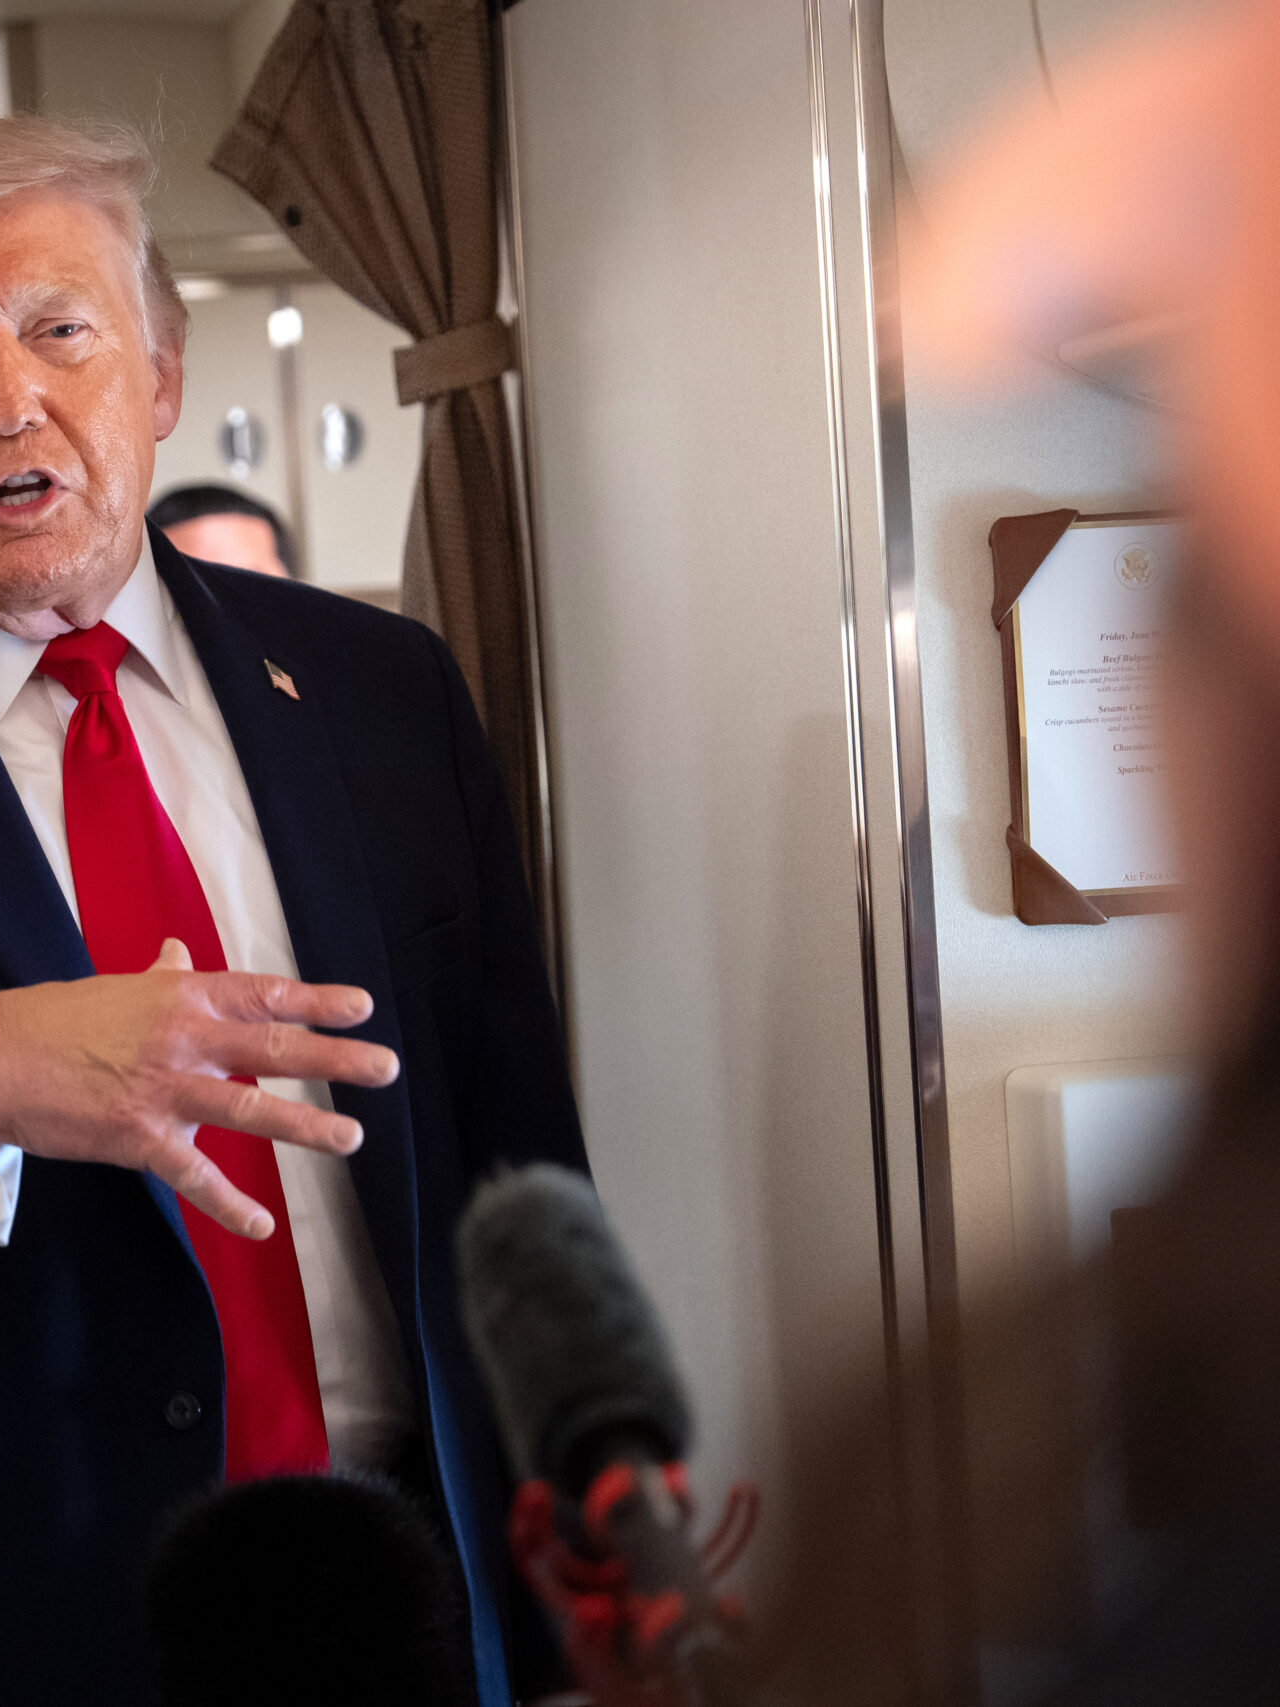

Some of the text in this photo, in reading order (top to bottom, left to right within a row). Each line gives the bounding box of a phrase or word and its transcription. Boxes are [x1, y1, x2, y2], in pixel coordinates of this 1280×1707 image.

[1099, 632, 1128, 642] Friday,
[1131, 631, 1150, 640] June
[1102, 654, 1122, 664] Beef
[1047, 677, 1069, 686] kimchi
[1089, 676, 1102, 684] and
[1098, 704, 1128, 714] Sesame
[1044, 718, 1064, 727] Crisp
[1064, 716, 1100, 725] cucumbers
